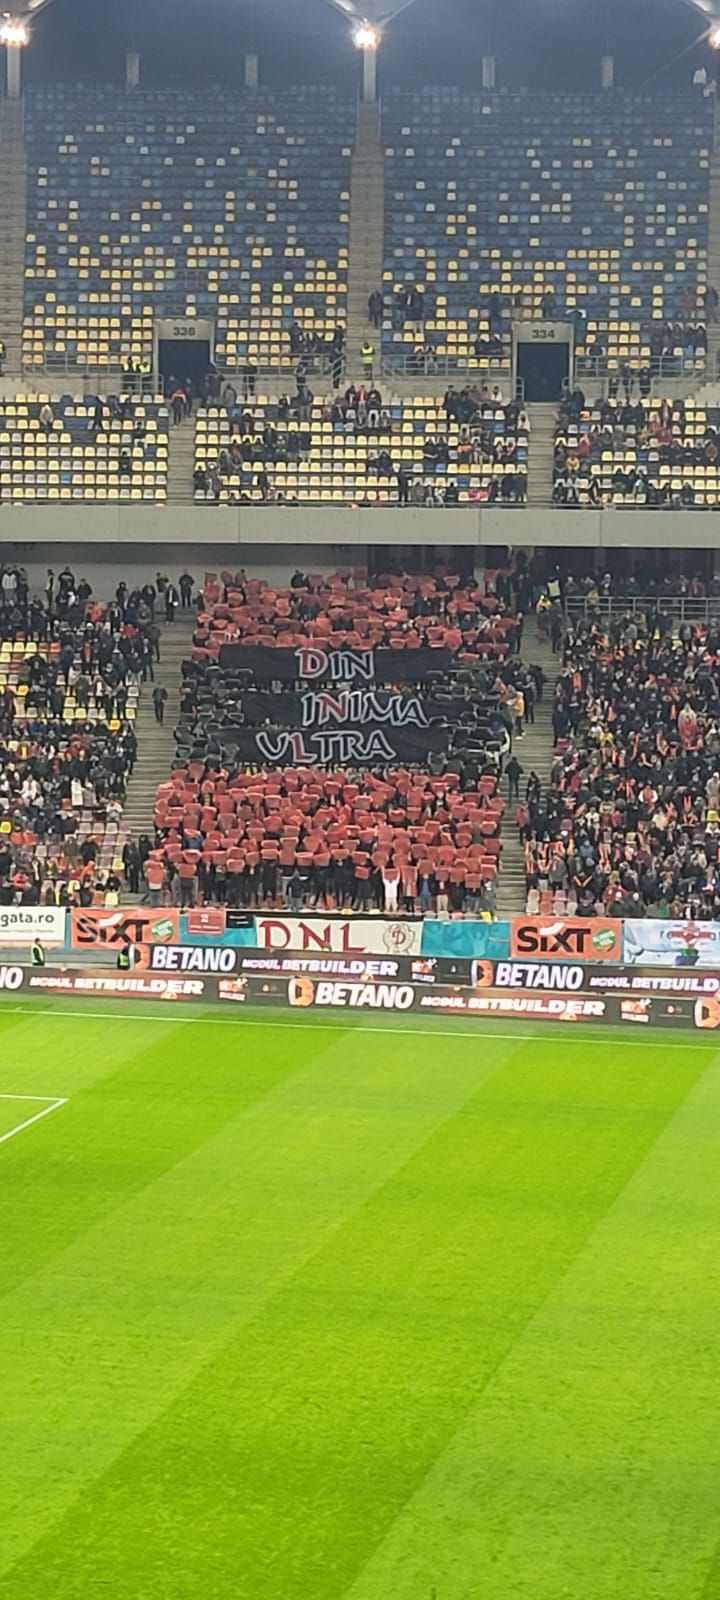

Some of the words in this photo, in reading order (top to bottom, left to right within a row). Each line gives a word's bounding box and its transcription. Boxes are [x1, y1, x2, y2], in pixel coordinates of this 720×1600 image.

[532, 329, 555, 339] 334
[295, 648, 375, 680] DIN
[302, 690, 430, 728] INIMA
[255, 730, 397, 763] ULTRA
[259, 920, 367, 952] DNL
[517, 922, 592, 953] SIXT
[151, 946, 236, 972] BETANO
[282, 959, 400, 976] BETBUILDER
[495, 963, 584, 990] BETANO
[74, 977, 205, 995] BETBUILDER
[315, 982, 414, 1009] BETANO
[468, 997, 606, 1016] BETBUILDER
